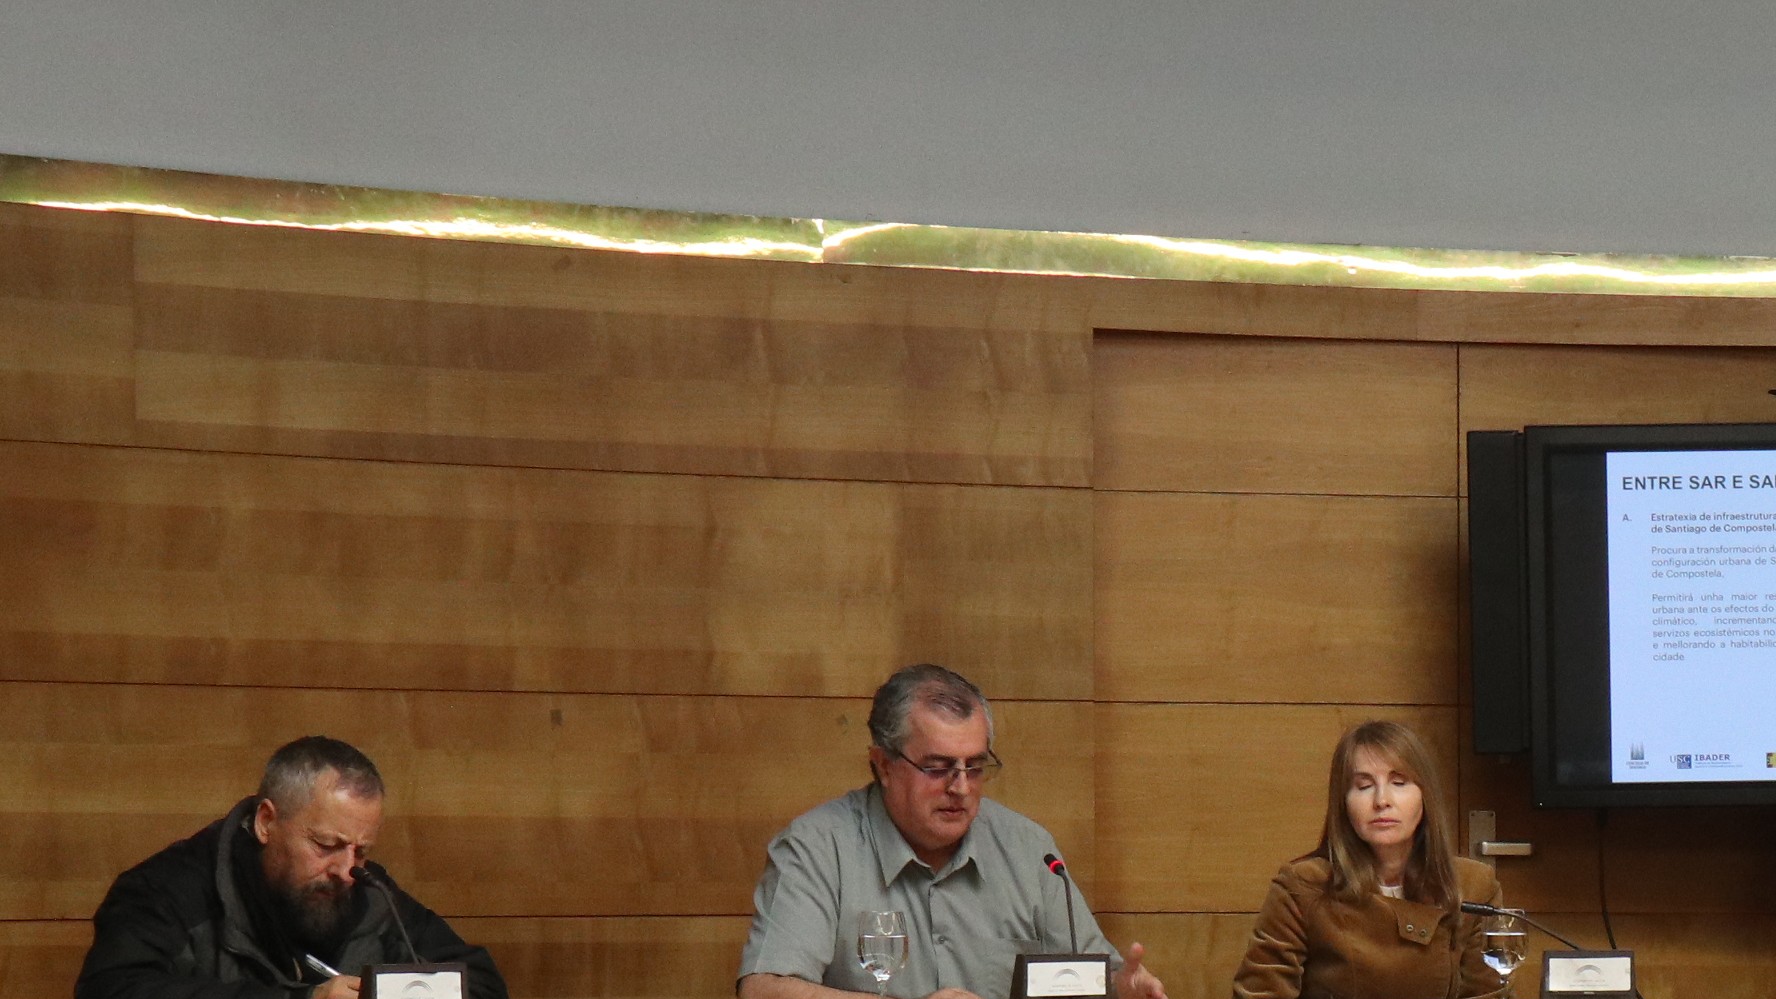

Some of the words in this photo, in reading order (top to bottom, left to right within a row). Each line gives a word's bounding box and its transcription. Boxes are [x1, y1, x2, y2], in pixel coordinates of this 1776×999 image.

[1622, 476, 1682, 490] ENTRE
[1689, 476, 1726, 489] SAR
[1733, 475, 1743, 488] E
[1651, 513, 1697, 521] Estratexia
[1699, 513, 1711, 521] de
[1714, 512, 1776, 520] infraestrutura
[1651, 525, 1663, 533] de
[1665, 524, 1707, 534] Santiago
[1709, 524, 1721, 532] de
[1652, 546, 1687, 554] Procura
[1697, 545, 1766, 554] transformación
[1652, 558, 1715, 567] configuración
[1719, 557, 1751, 565] urbana
[1652, 570, 1663, 578] de
[1652, 593, 1693, 602] Permitirá
[1701, 593, 1723, 601] unha
[1653, 606, 1684, 614] urbana
[1725, 605, 1758, 613] efectos
[1762, 604, 1773, 612] do
[1694, 629, 1760, 637] ecosistémicos
[1653, 653, 1684, 661] cidade
